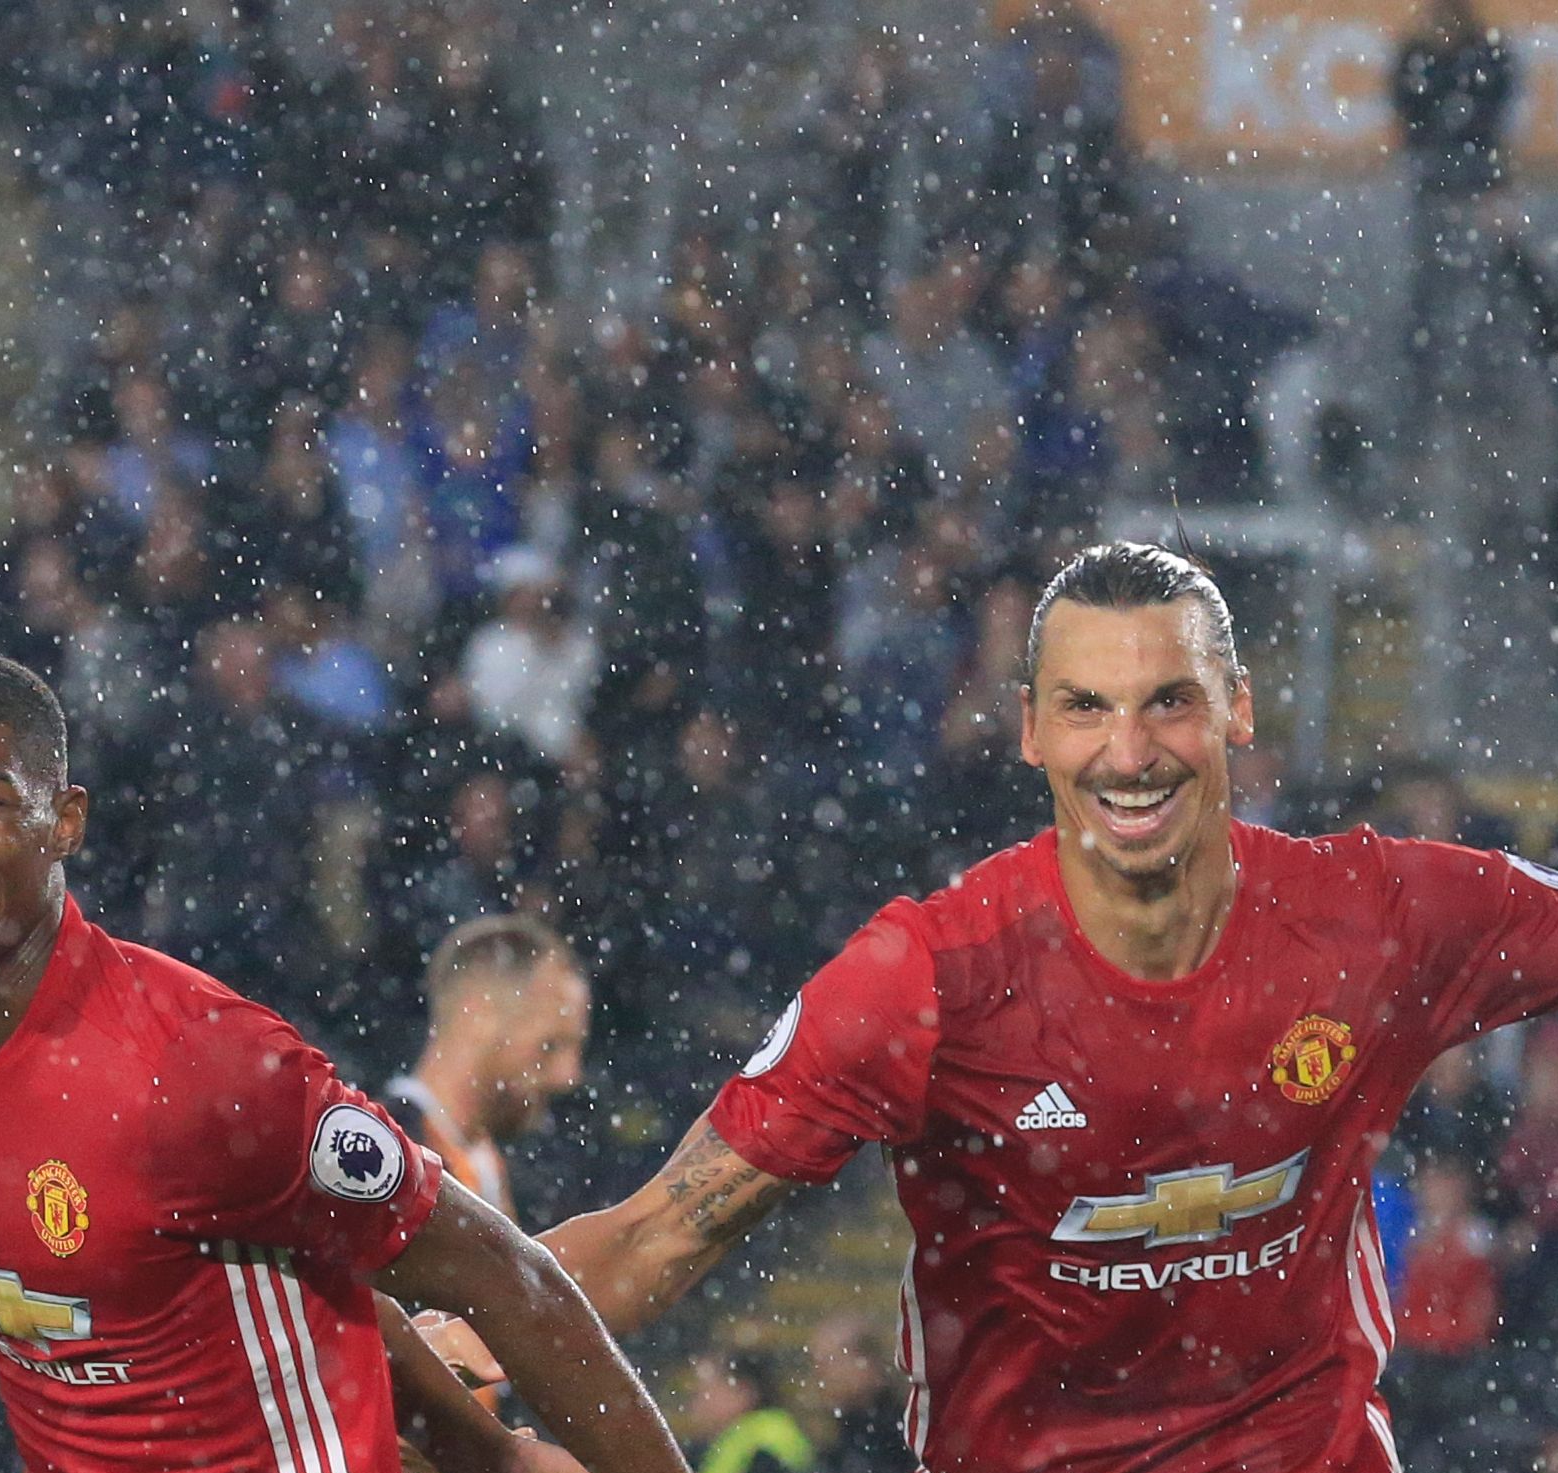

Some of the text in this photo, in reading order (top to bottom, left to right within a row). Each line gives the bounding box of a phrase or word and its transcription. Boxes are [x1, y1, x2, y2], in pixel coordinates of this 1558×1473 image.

[1015, 1109, 1088, 1131] adidas
[41, 1227, 76, 1252] UNITED
[1049, 1224, 1306, 1291] CHEVROLET
